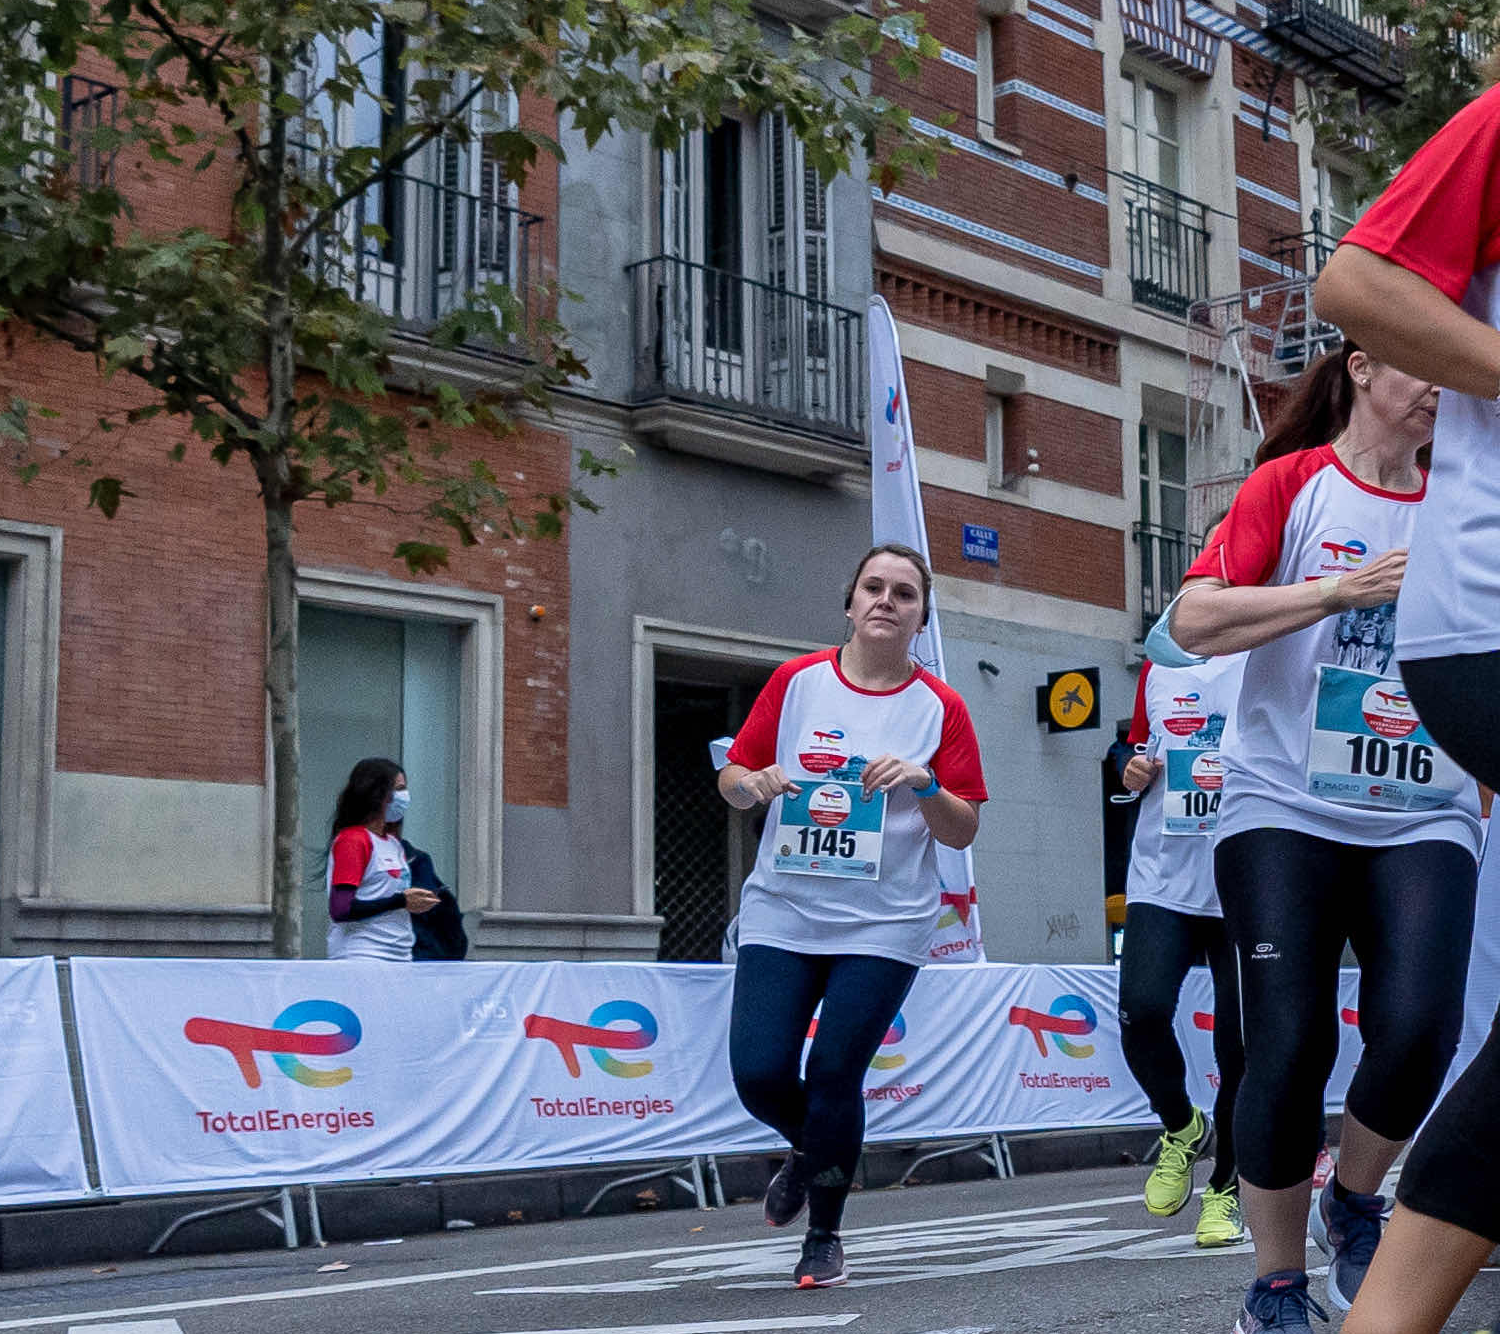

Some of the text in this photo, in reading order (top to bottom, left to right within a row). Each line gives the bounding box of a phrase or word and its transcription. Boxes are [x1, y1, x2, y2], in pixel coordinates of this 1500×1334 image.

[1346, 735, 1434, 785] 1016
[1182, 791, 1222, 817] 104
[797, 826, 857, 859] 1145
[1020, 1072, 1111, 1093] TotalEnergies
[196, 1106, 375, 1135] TotalEnergies
[530, 1094, 675, 1120] TotalEnergies
